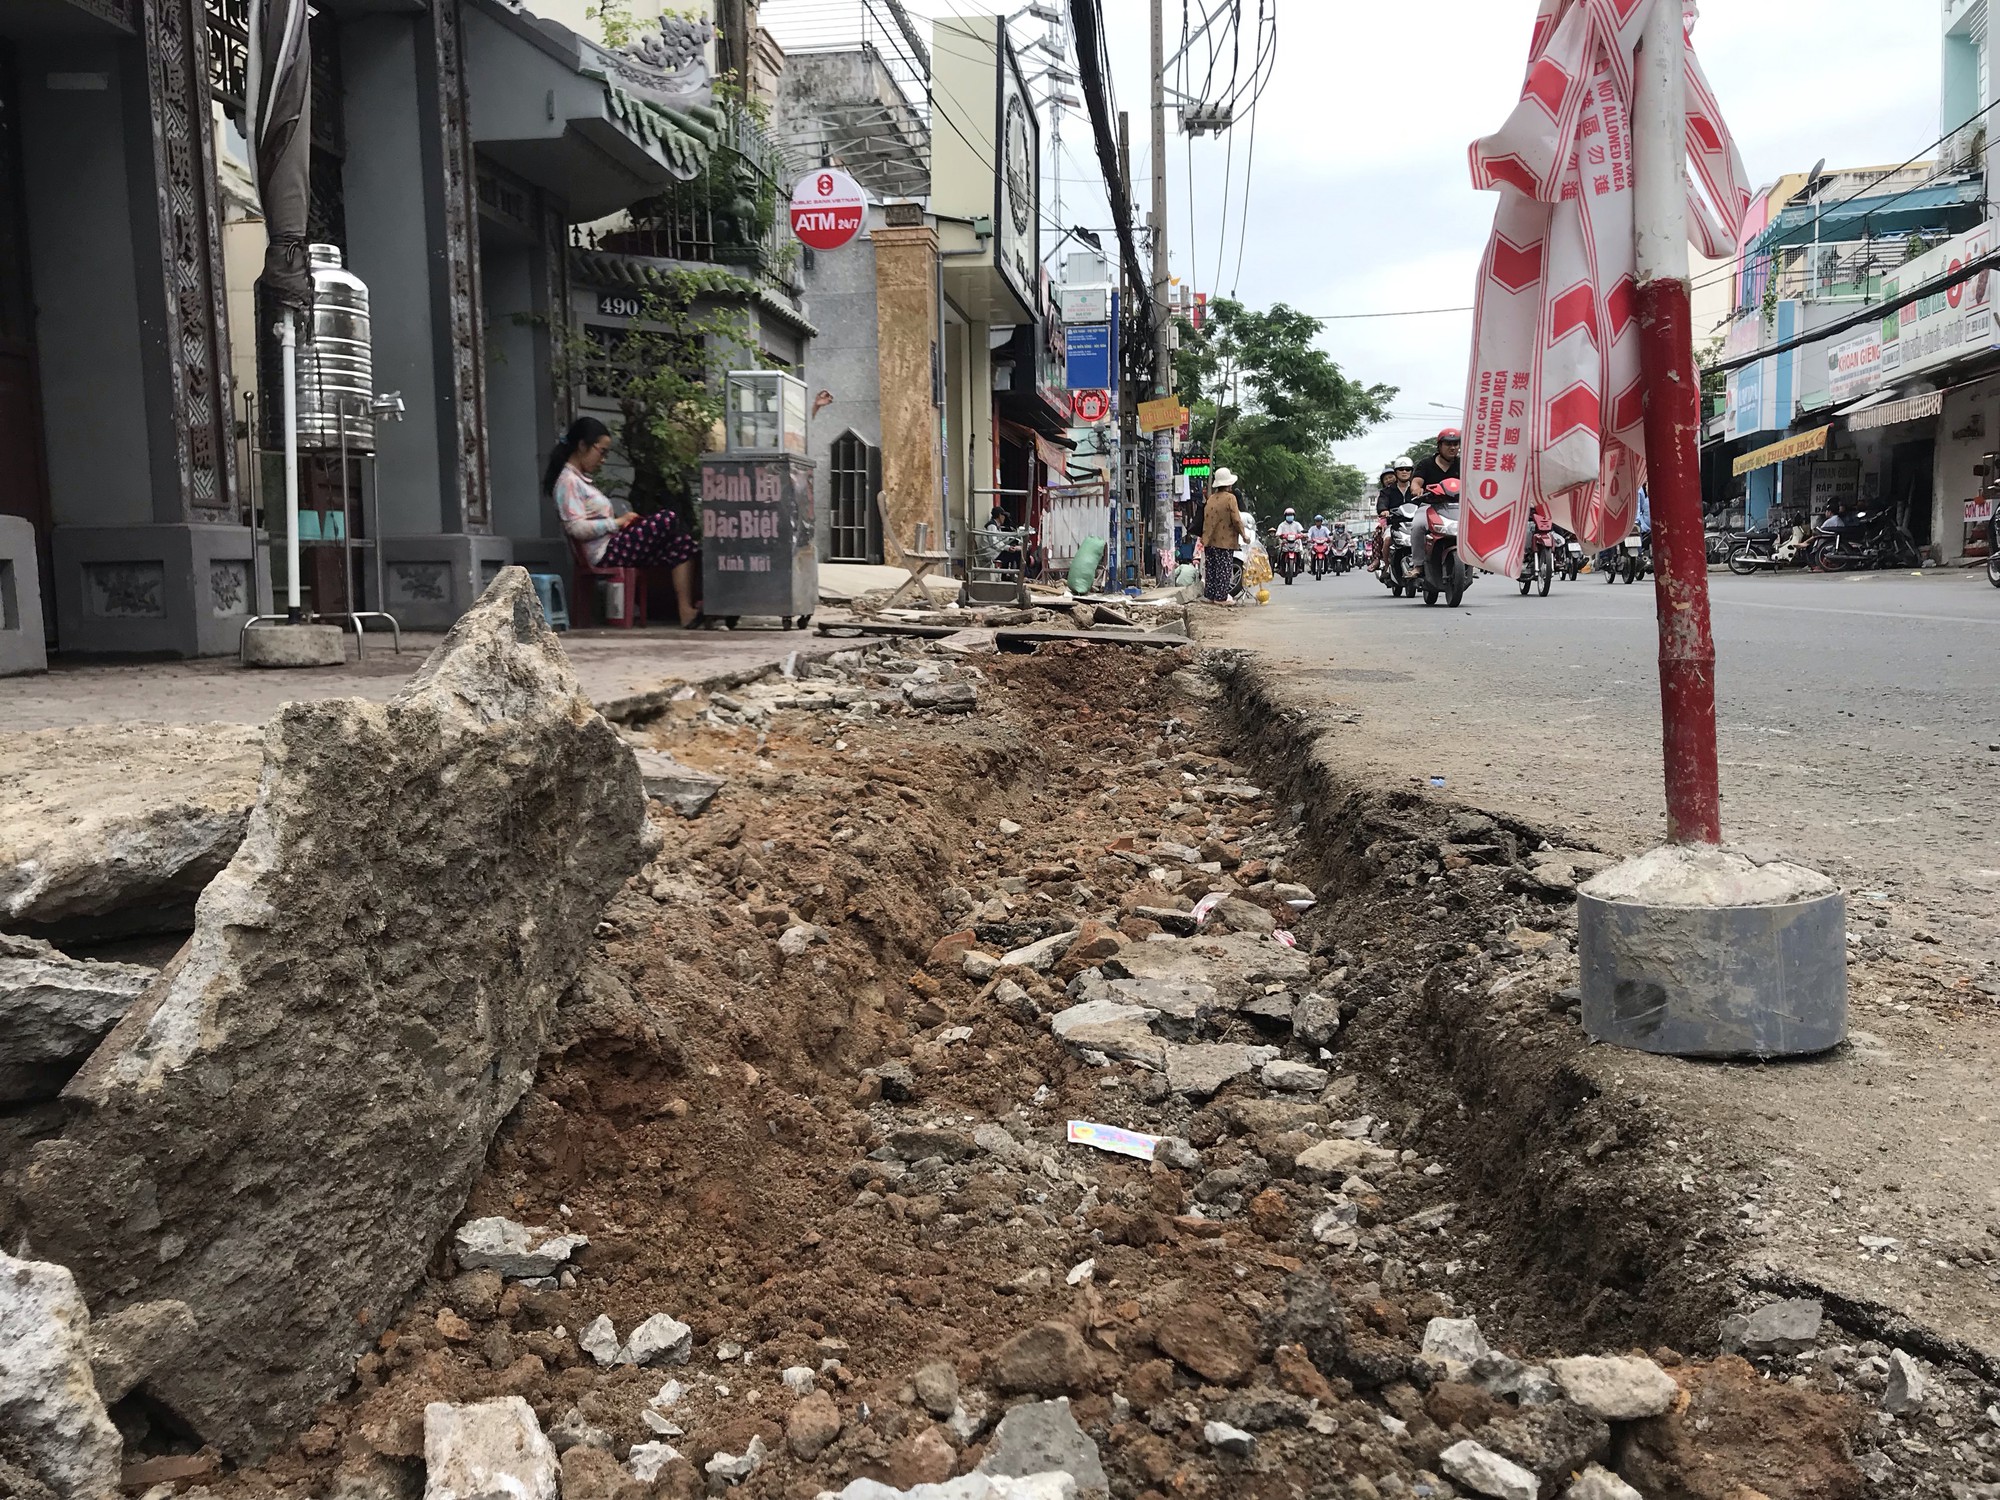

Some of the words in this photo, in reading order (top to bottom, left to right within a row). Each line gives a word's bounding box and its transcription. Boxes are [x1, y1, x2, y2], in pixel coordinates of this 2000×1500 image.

[1597, 80, 1616, 102] NOT
[1602, 105, 1622, 160] ALLOWED
[1612, 162, 1625, 192] AREA
[795, 212, 836, 232] ATM
[838, 218, 858, 230] 24/7
[600, 297, 638, 316] 490
[1838, 350, 1858, 372] KHOAN
[1479, 371, 1492, 394] VÀO
[1492, 370, 1508, 398] AREA
[1476, 396, 1488, 420] CẤM
[1486, 400, 1504, 450] ALLOWED
[1500, 372, 1530, 472] 禁區勿進
[1474, 423, 1486, 446] VỰC
[1472, 448, 1482, 470] KHU
[1484, 451, 1498, 472] NOT
[702, 466, 752, 502] Bánh
[703, 508, 738, 544] Đặc
[740, 509, 779, 544] Biệt
